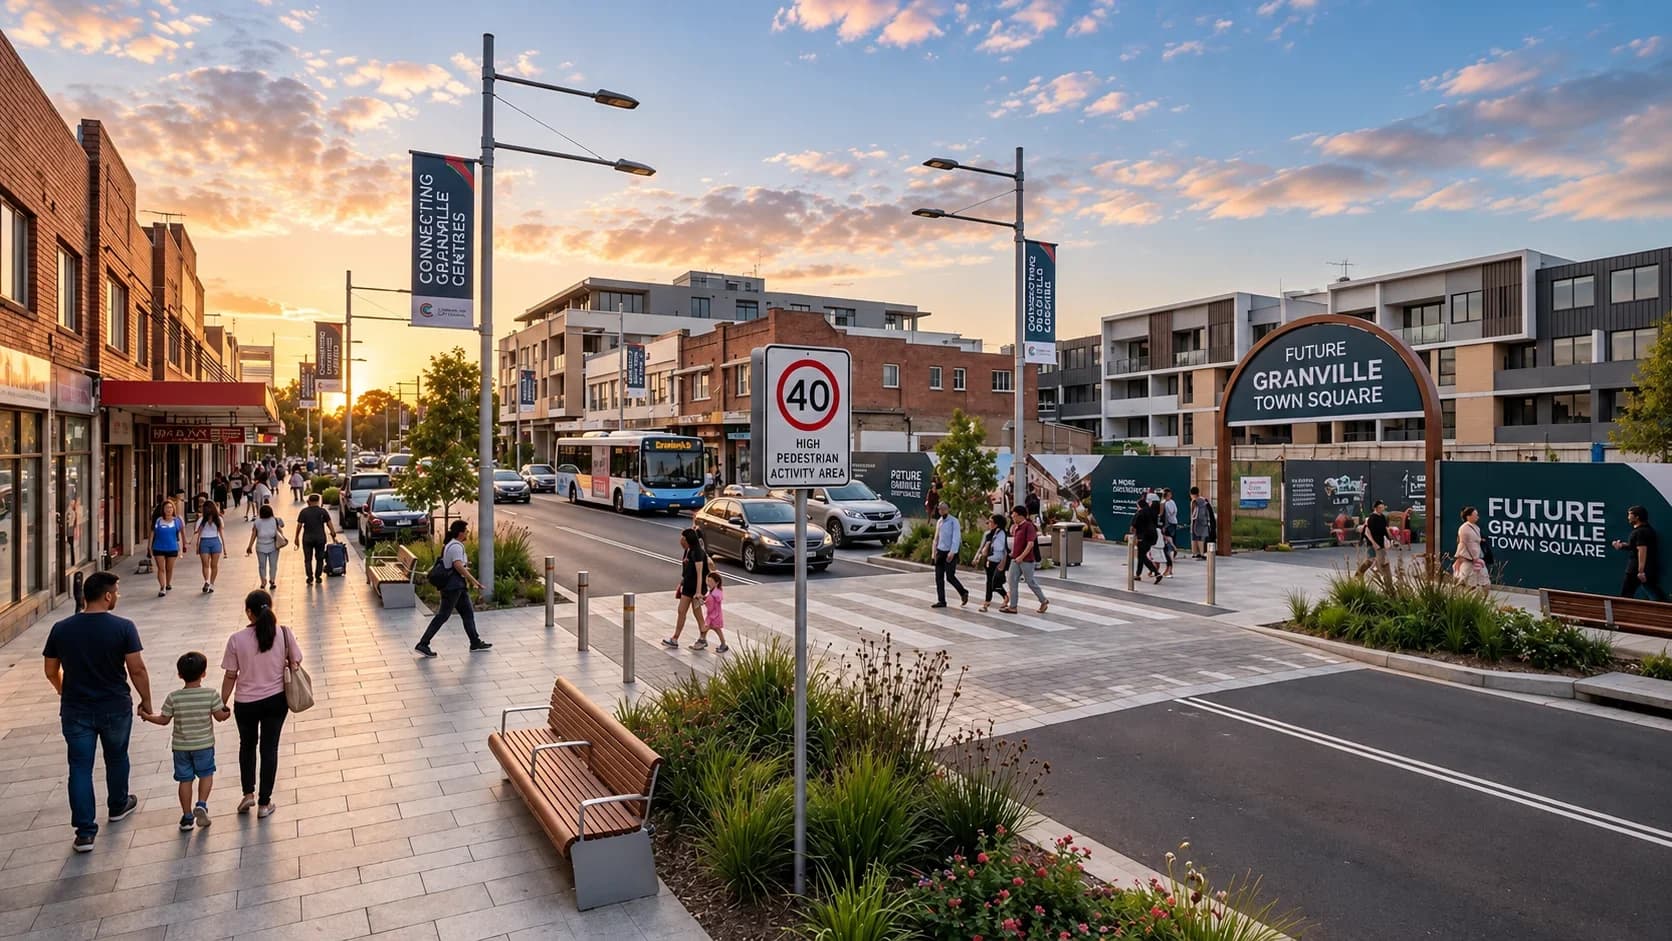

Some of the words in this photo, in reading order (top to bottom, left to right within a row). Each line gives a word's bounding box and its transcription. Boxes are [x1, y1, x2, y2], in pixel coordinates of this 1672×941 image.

[419, 173, 433, 284] CONNECTING
[1285, 340, 1347, 362] FUTURE
[1253, 359, 1383, 391] GRANVILLE
[786, 379, 830, 412] 40
[1253, 392, 1303, 411] TOWN
[1307, 386, 1383, 408] SQUARE
[796, 438, 820, 449] HIGH
[776, 452, 839, 464] PEDESTRIAN
[770, 467, 815, 479] ACTIVITY
[818, 467, 845, 479] AREA
[1488, 497, 1605, 524] FUTURE
[1488, 519, 1606, 542] GRANVILLE
[1488, 535, 1535, 551] TOWN
[1539, 540, 1606, 558] SQUARE
